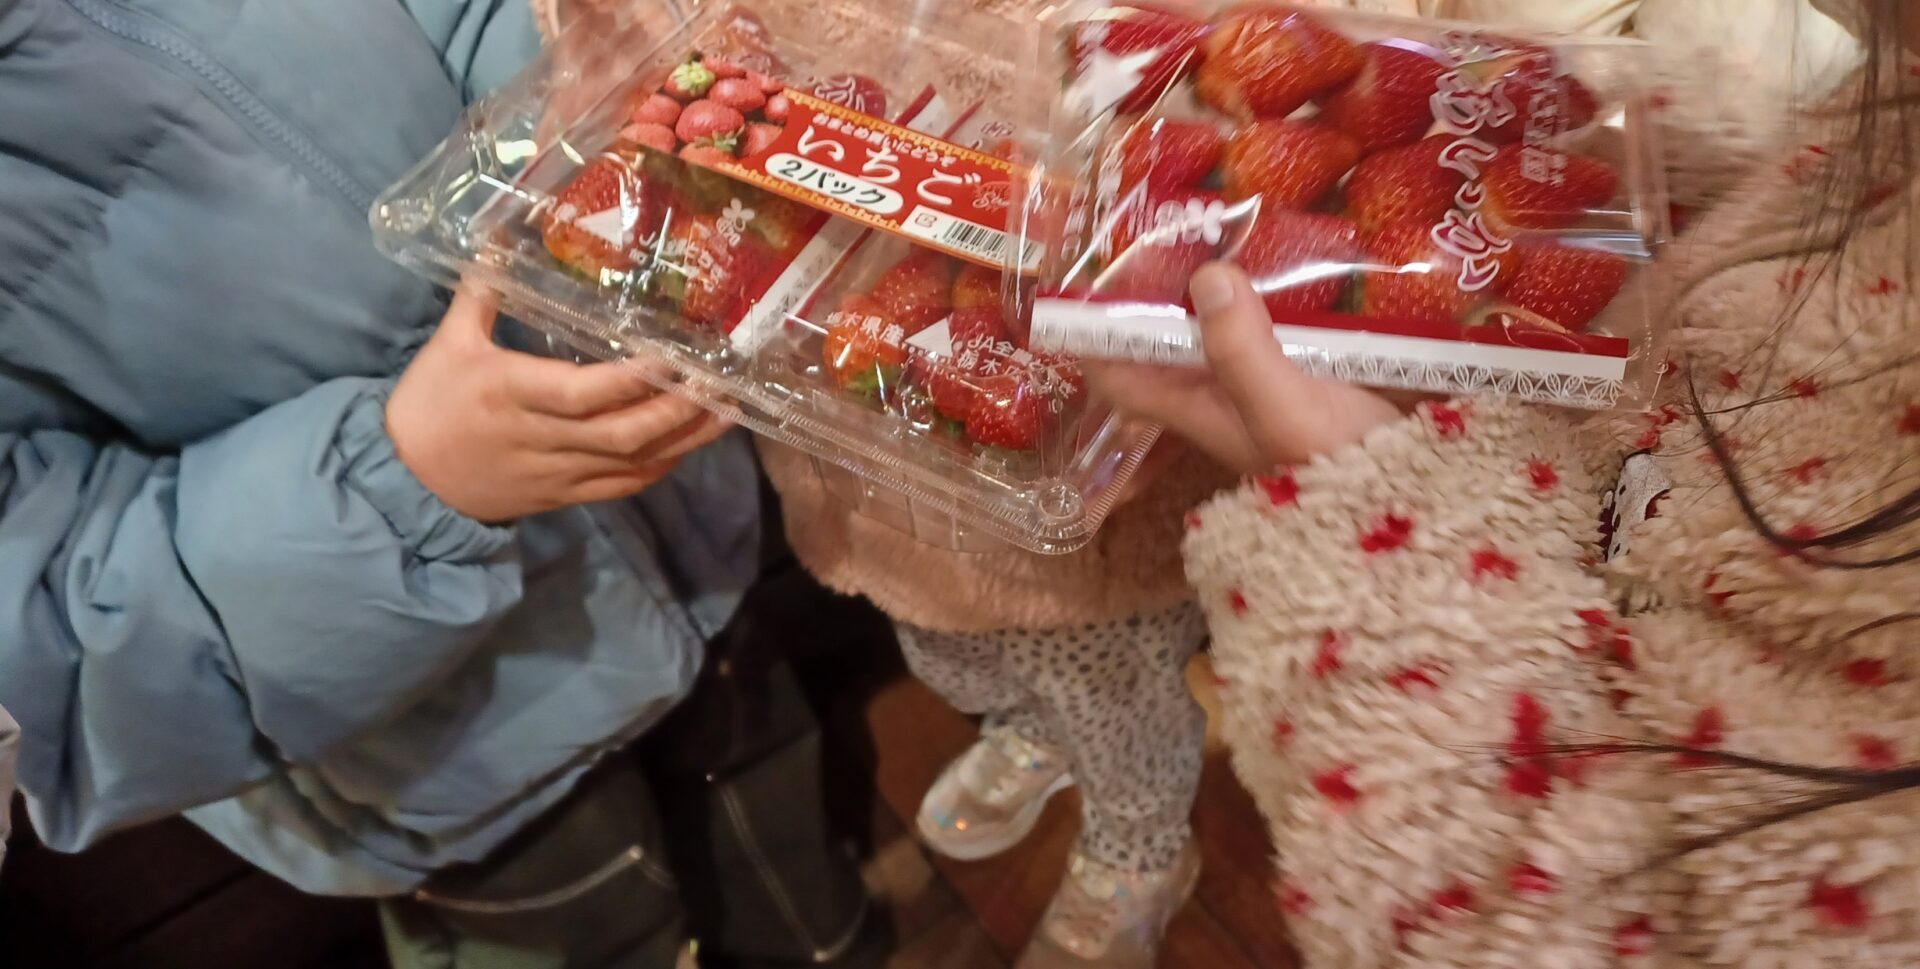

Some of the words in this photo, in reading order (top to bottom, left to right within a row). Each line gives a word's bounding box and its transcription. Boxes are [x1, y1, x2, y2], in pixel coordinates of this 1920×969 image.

[779, 159, 887, 205] 2パック
[797, 125, 981, 206] いちご
[825, 311, 905, 347] 栃木県産
